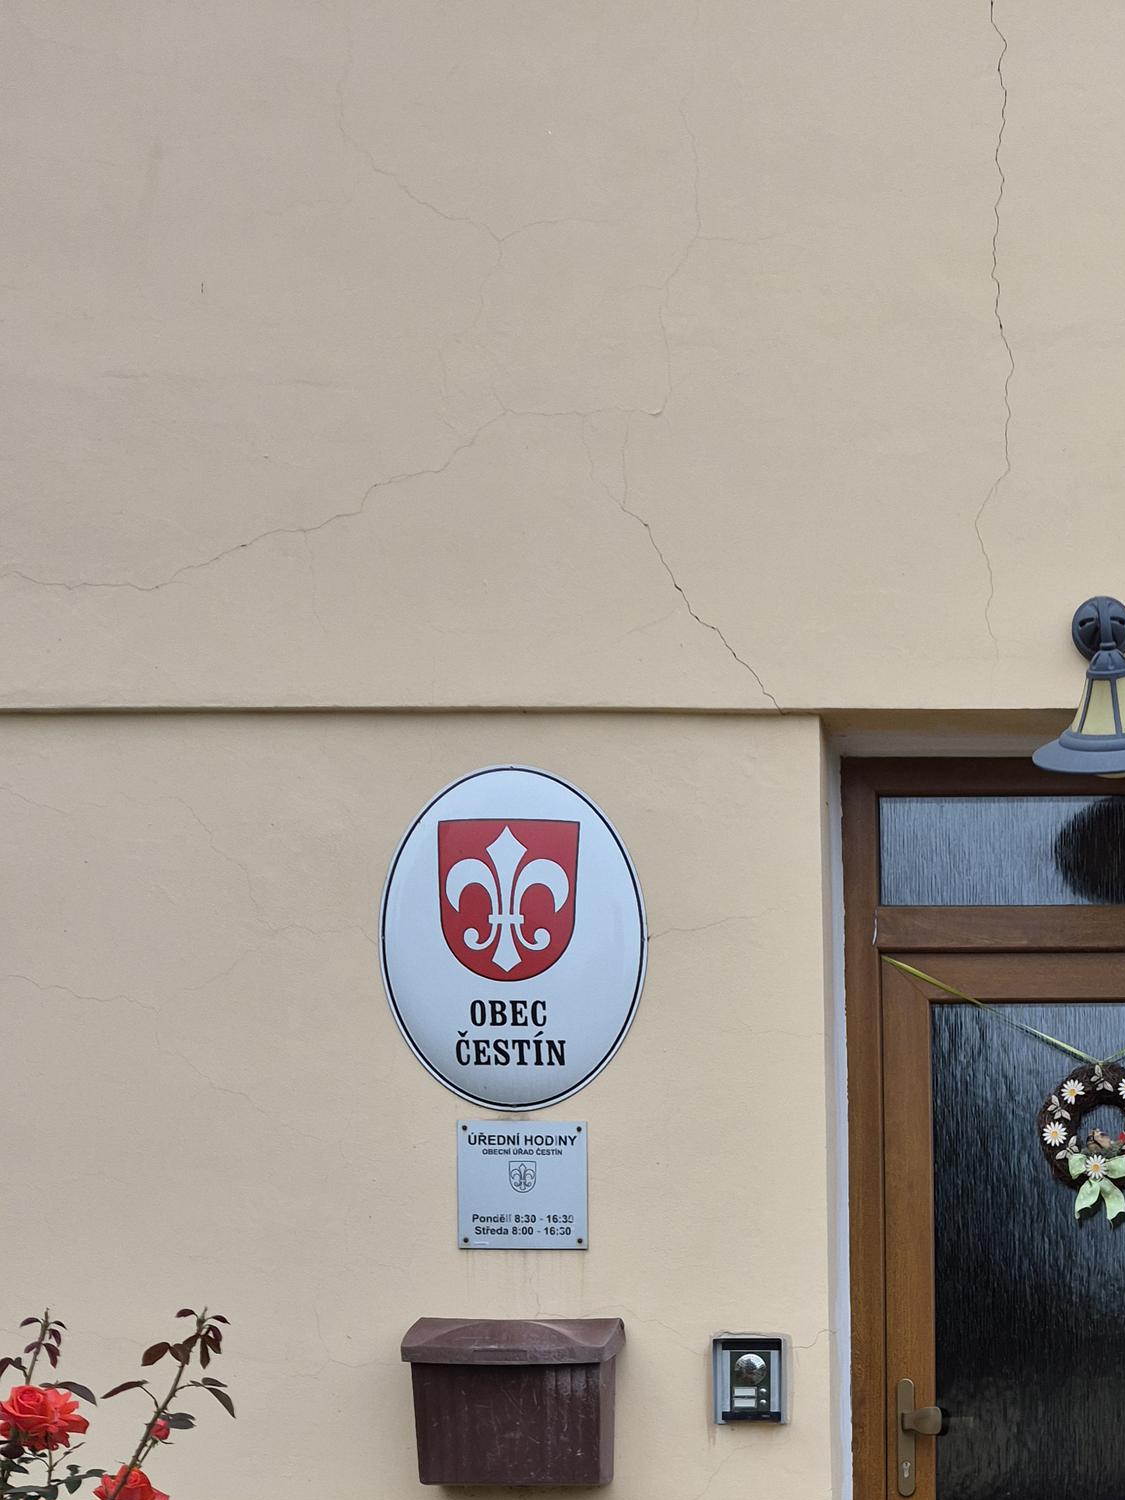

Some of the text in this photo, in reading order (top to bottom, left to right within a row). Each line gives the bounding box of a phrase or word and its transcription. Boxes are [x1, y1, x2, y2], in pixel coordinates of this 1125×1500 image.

[470, 1000, 547, 1027] OBEC
[455, 1030, 566, 1066] ČESTÍN
[468, 1132, 577, 1146] ÚŘEDNÍ HODINY
[514, 1214, 537, 1223] 8:30
[546, 1214, 574, 1223] 16:30
[474, 1226, 509, 1235] Středa
[511, 1226, 534, 1235] 8:00
[544, 1226, 571, 1236] 16:30
